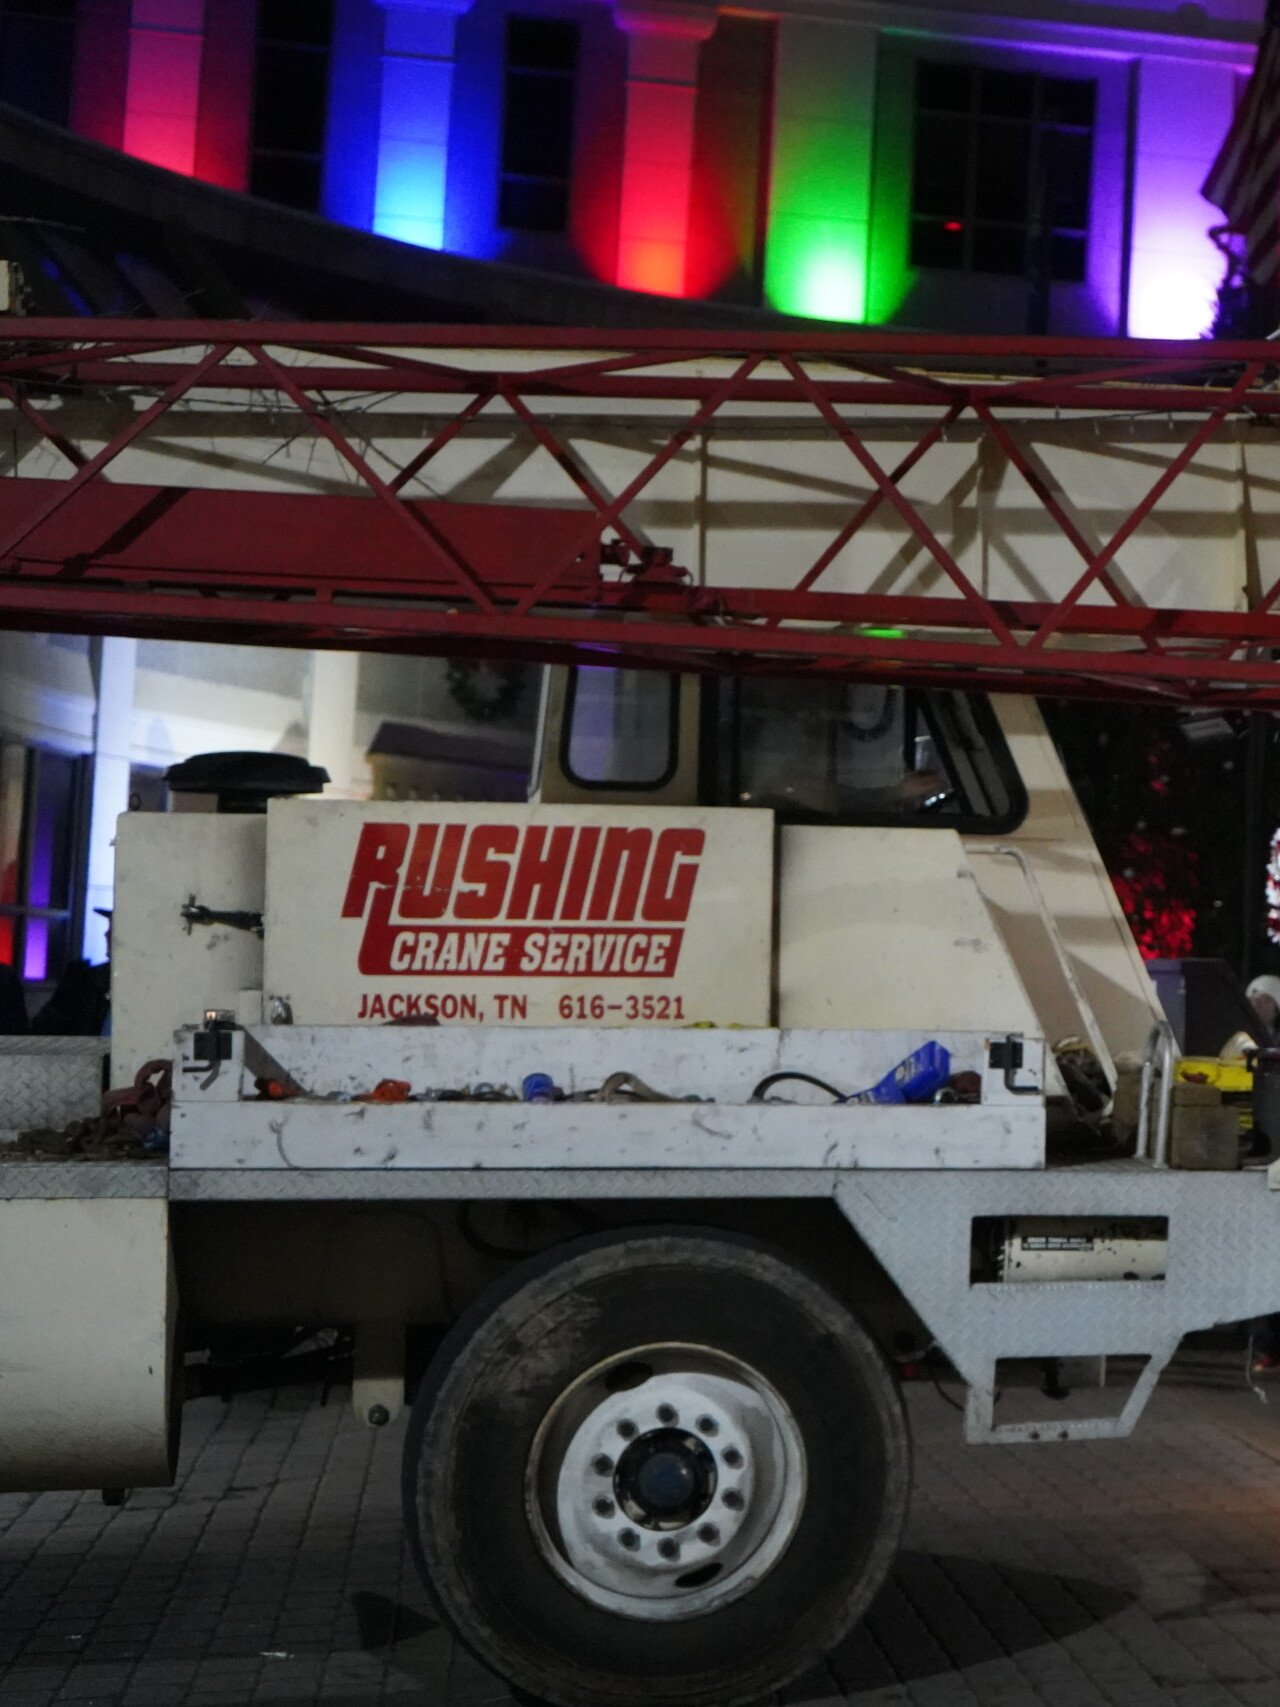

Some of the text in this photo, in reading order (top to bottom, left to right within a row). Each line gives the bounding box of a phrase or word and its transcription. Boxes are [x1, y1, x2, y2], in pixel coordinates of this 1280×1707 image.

[341, 822, 706, 922] RUSHING
[389, 931, 671, 974] CRANE SERVICE
[358, 994, 685, 1022] JACKSON, TN 616-3521
